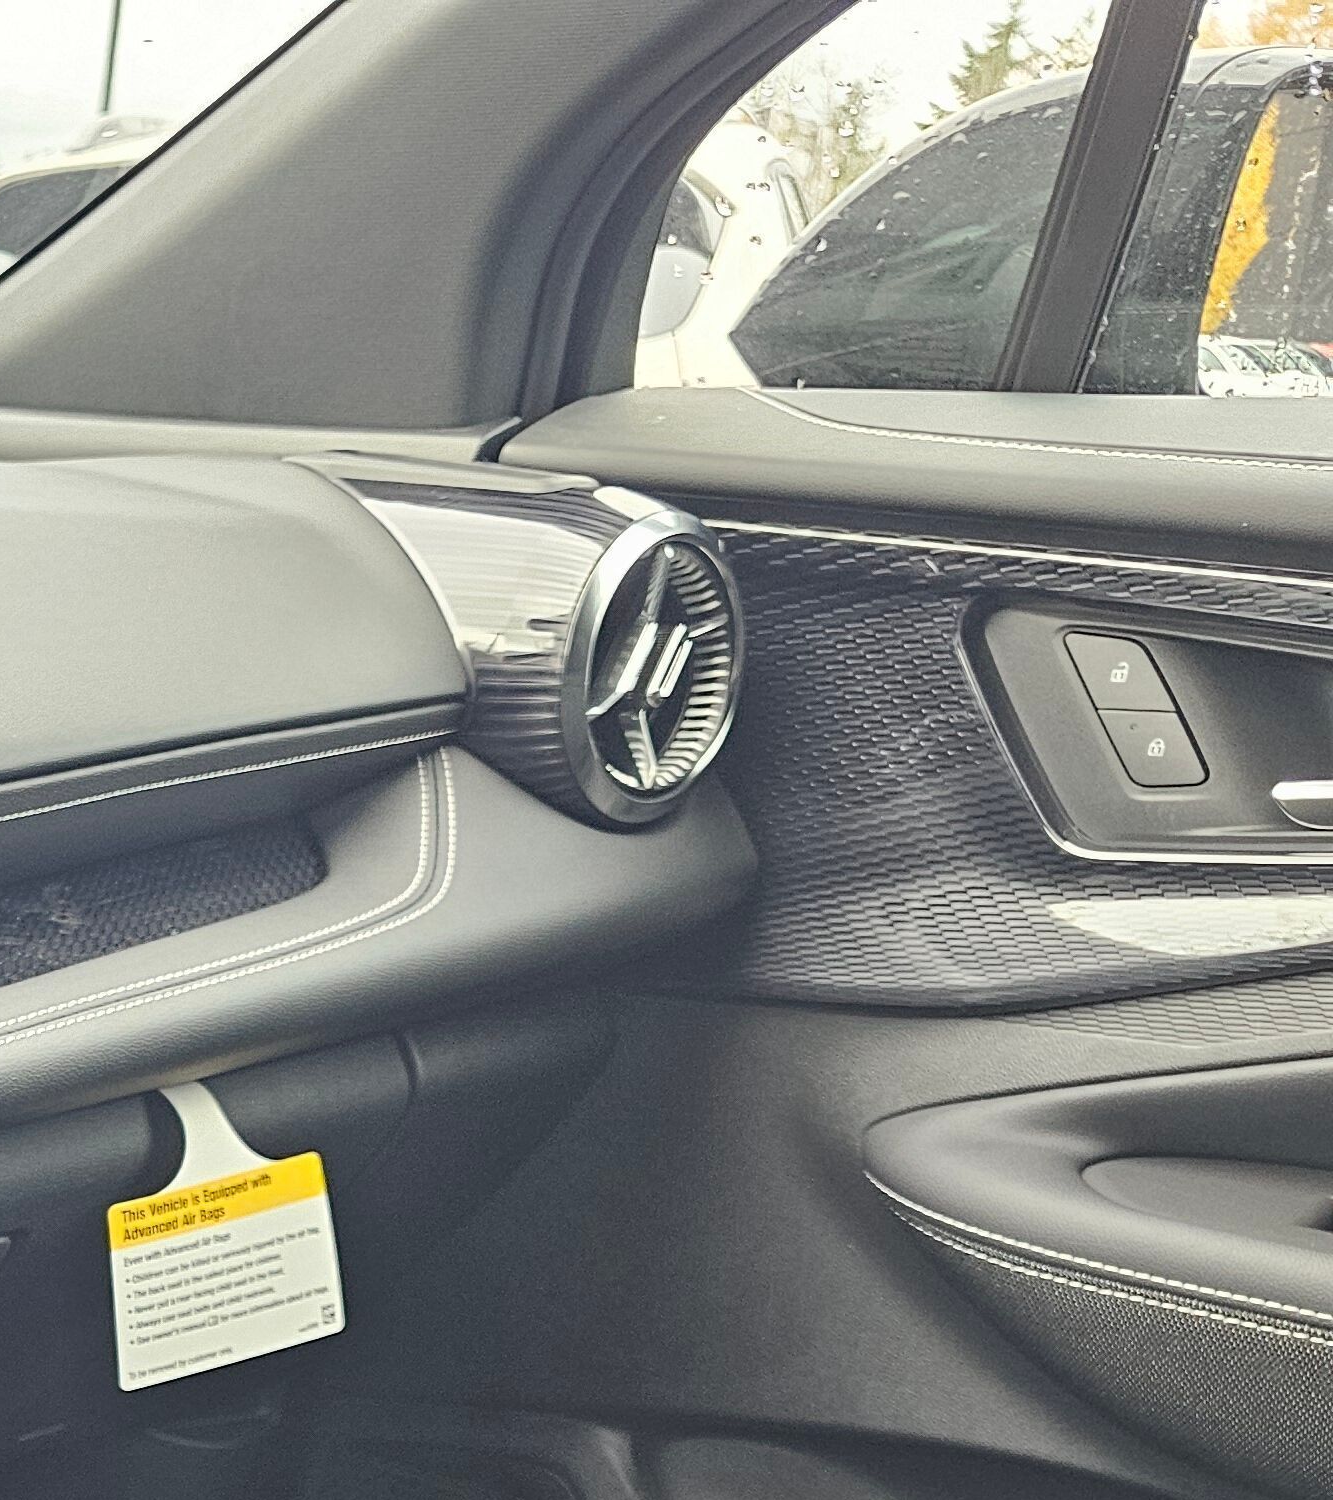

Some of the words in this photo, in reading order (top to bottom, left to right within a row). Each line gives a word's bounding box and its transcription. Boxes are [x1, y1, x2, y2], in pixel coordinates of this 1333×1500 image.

[121, 1210, 146, 1224] This
[149, 1198, 188, 1217] Vehicle
[203, 1179, 248, 1203] Equipped
[252, 1173, 272, 1189] with
[123, 1217, 179, 1242] Advanced
[182, 1212, 196, 1226] Air
[200, 1206, 226, 1223] Bags
